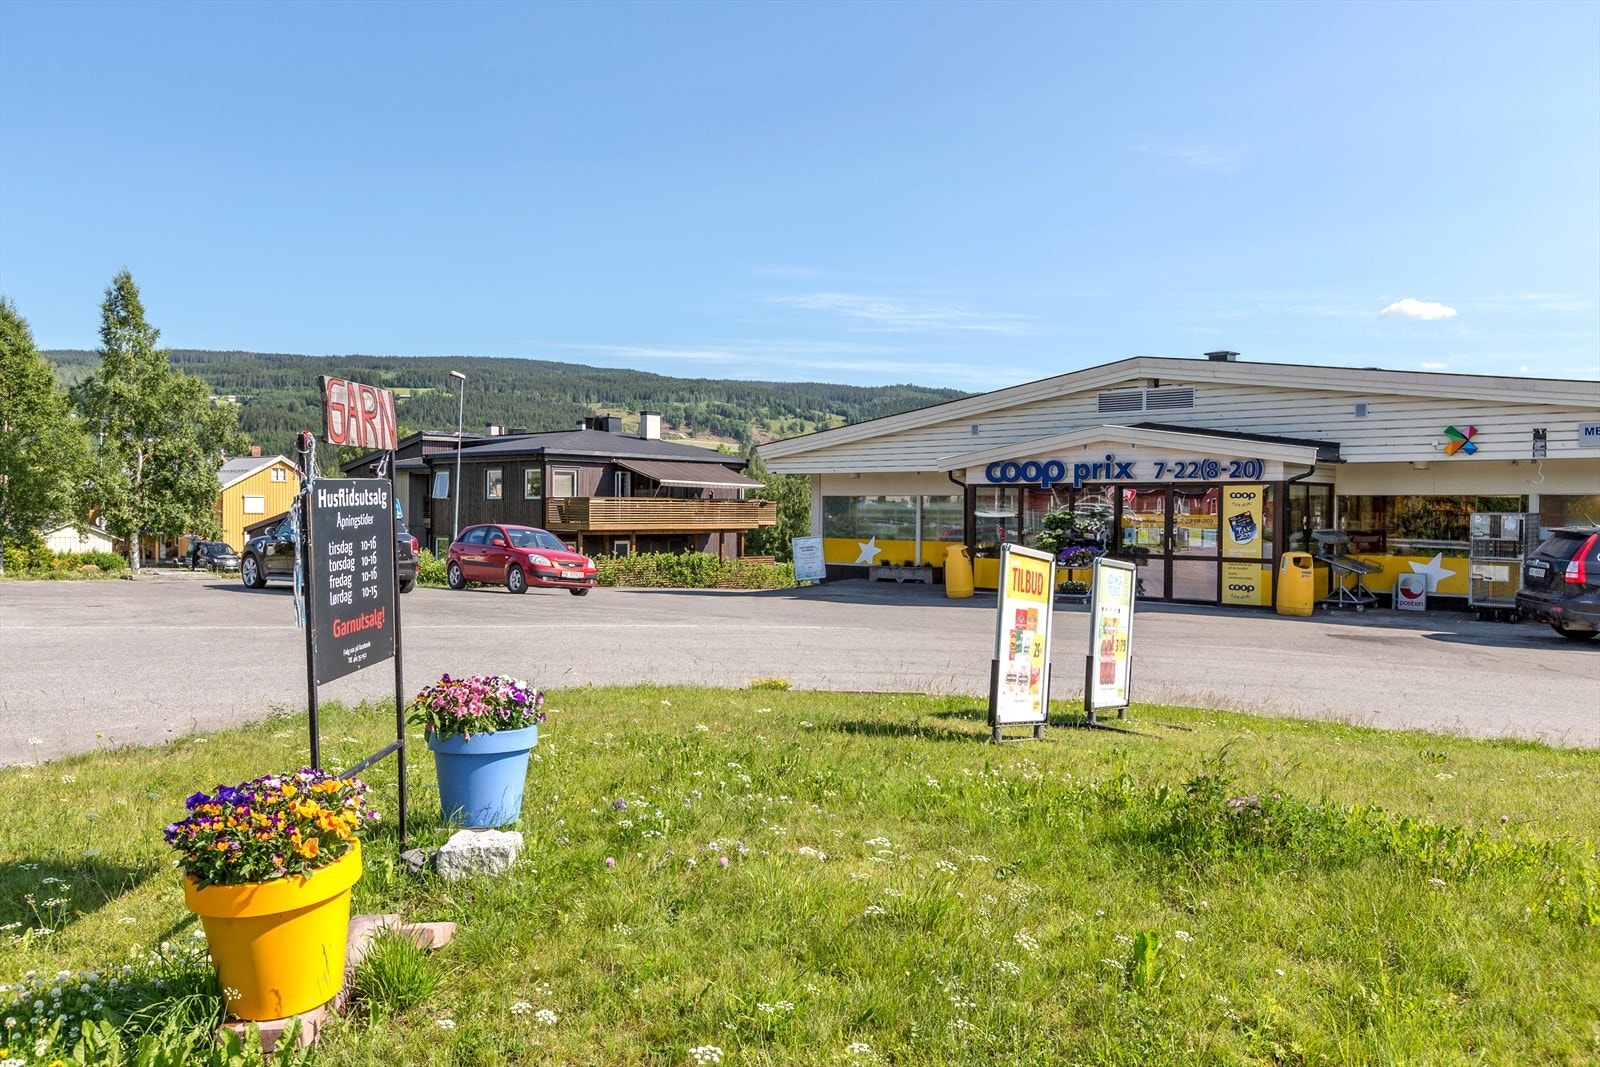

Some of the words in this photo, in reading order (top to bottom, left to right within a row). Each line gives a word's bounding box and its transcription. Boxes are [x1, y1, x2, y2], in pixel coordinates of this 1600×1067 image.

[327, 377, 397, 449] GARN
[985, 460, 1066, 488] coop
[1073, 454, 1136, 488] prix
[1153, 459, 1264, 481] 7-22(8-20)
[318, 488, 387, 509] Husflidsutsalg
[1230, 492, 1256, 500] coop
[336, 512, 374, 530] Åpningstider
[328, 540, 353, 556] tirsdag
[361, 536, 377, 551] 10-16
[329, 556, 355, 572] torsdag
[361, 551, 377, 566] 10-16
[329, 573, 353, 589] fredag
[361, 566, 378, 582] 10-16
[1012, 567, 1044, 596] TILBUD
[329, 589, 353, 606] lørdag
[362, 585, 378, 599] 10-15
[1228, 584, 1255, 593] coop
[1399, 599, 1424, 608] posten
[333, 606, 385, 638] Garnutsalg!
